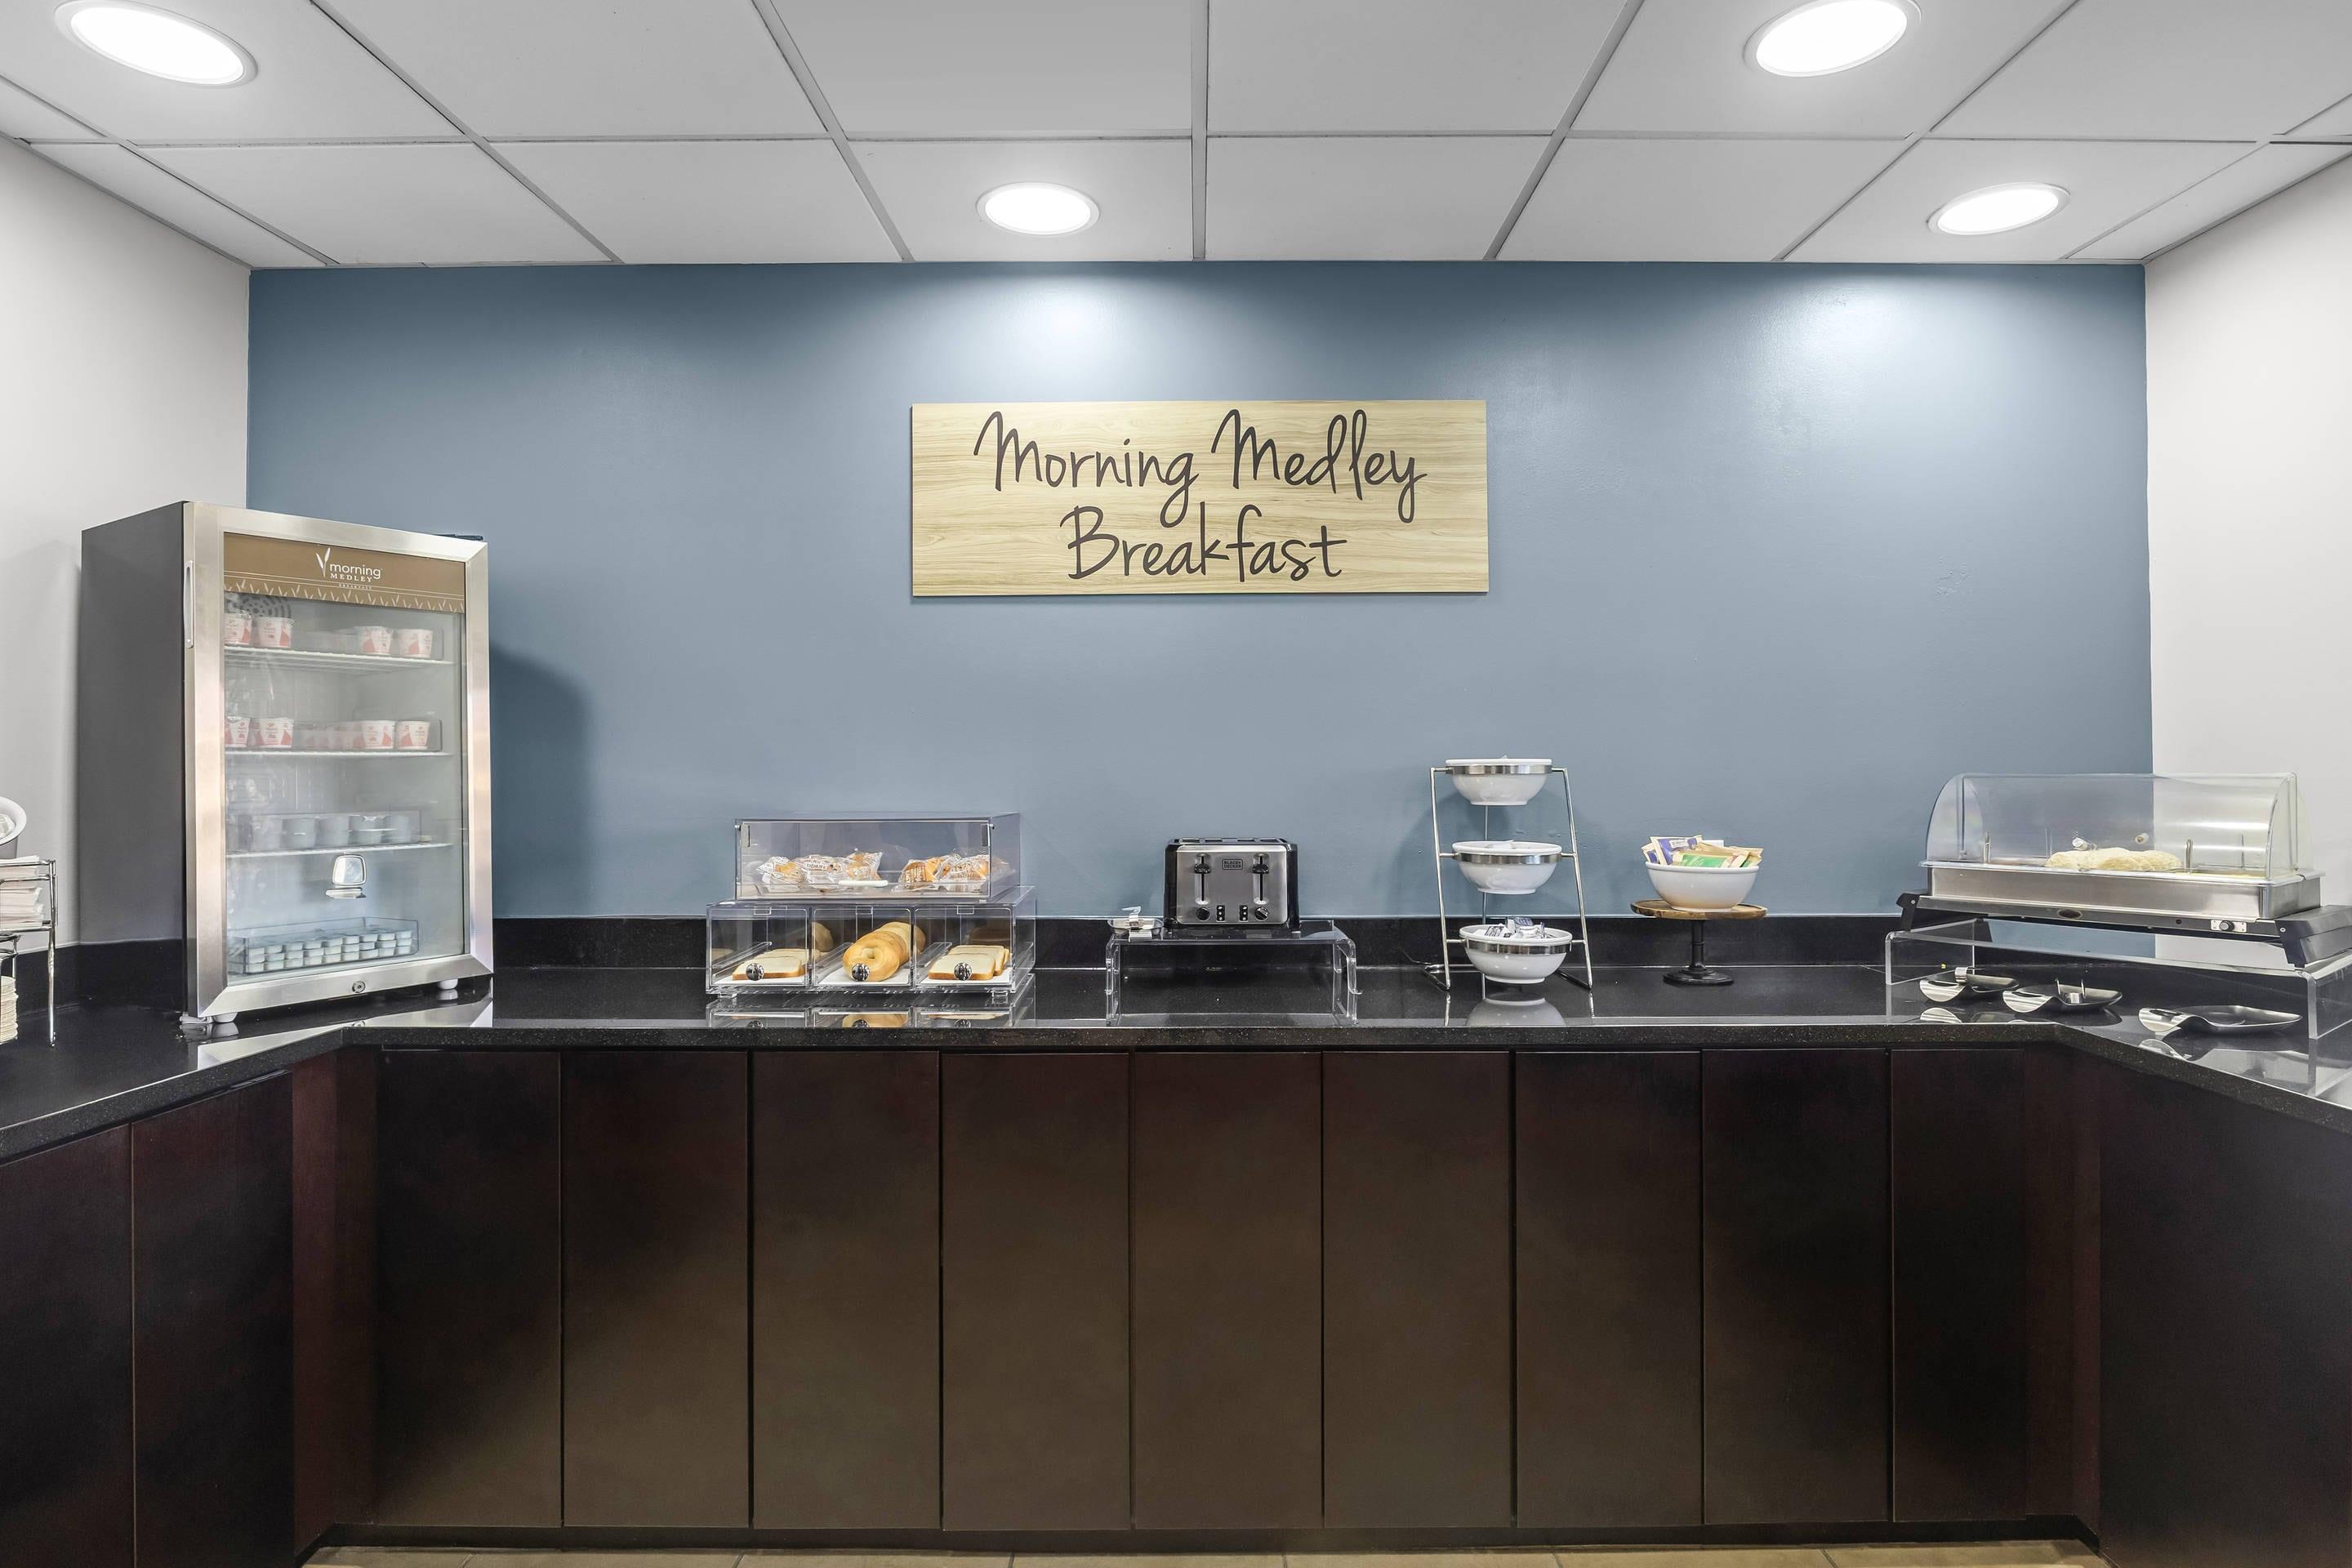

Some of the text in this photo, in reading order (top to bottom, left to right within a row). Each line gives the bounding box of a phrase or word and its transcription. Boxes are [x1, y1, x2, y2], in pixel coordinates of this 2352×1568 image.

[973, 408, 1428, 528] Morning Medley
[1059, 501, 1348, 583] Breakfast
[330, 564, 381, 580] morning
[330, 572, 372, 582] MEDLEY
